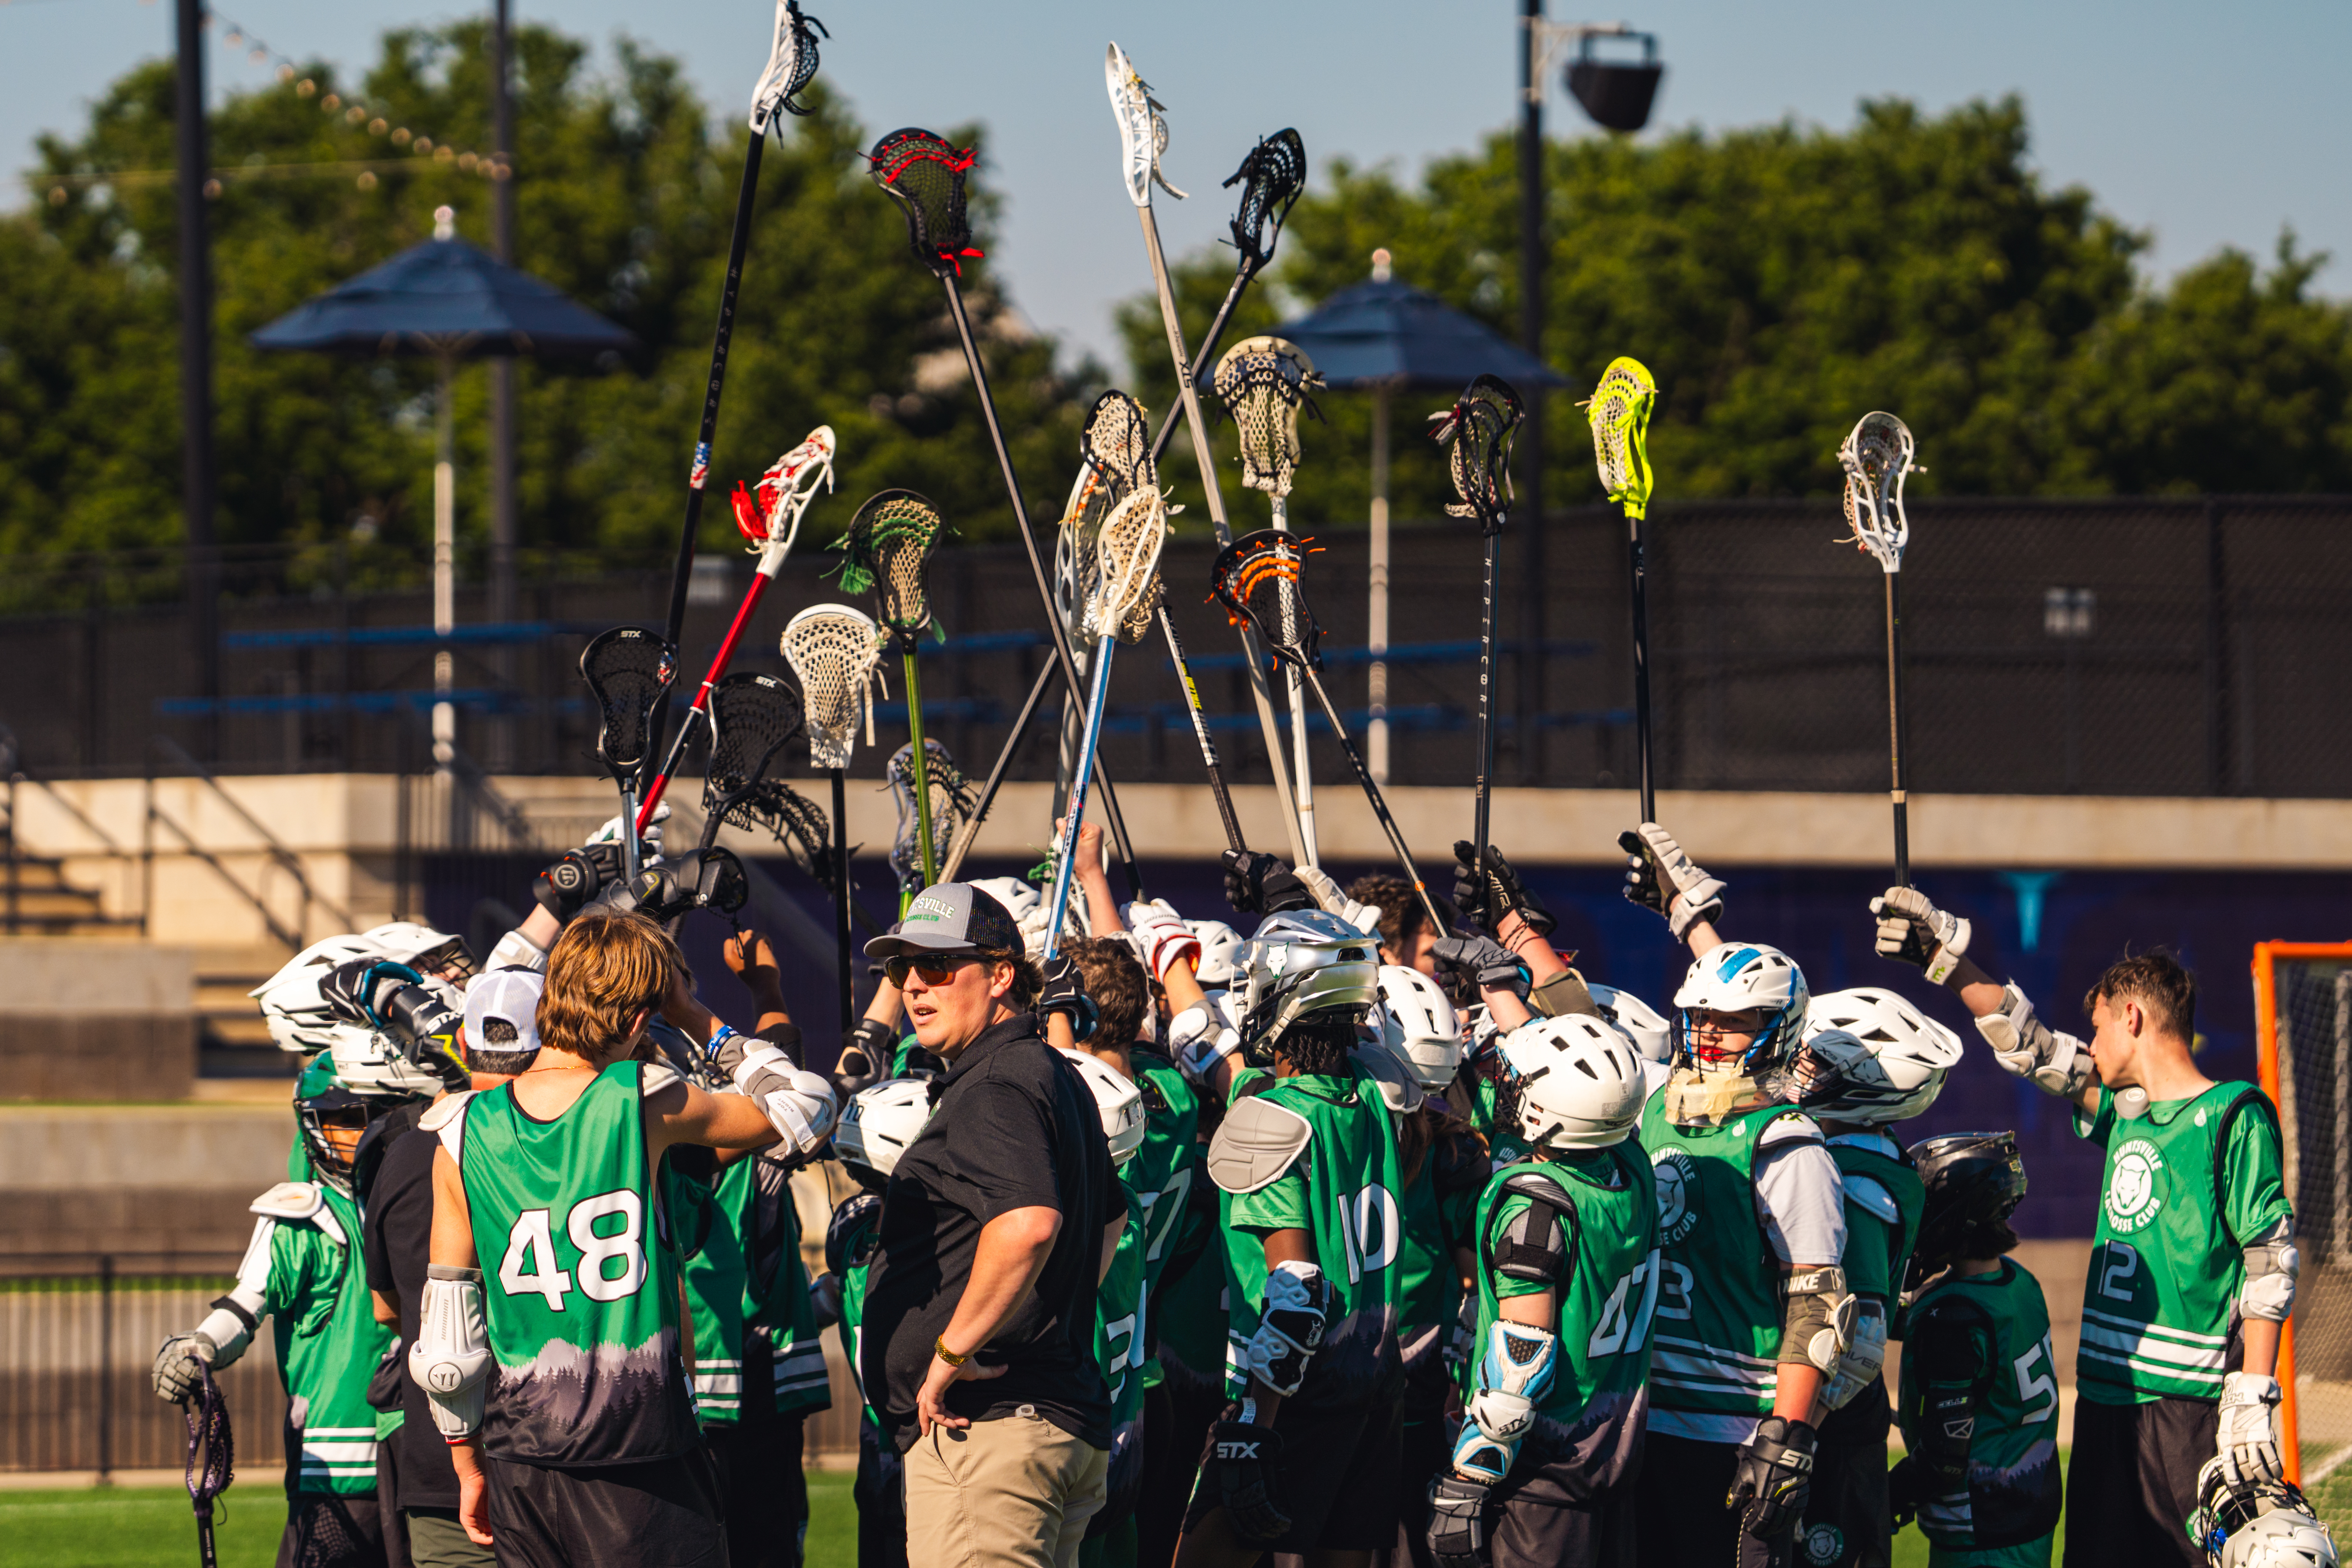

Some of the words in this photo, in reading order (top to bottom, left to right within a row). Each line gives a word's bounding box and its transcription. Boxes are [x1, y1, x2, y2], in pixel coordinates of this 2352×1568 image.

[1181, 362, 1194, 389] STX
[620, 630, 642, 639] STX
[1479, 558, 1492, 721] HYPERCORE
[755, 675, 777, 689] STX
[426, 1011, 463, 1034] STX
[777, 1098, 794, 1112] RIGHT
[777, 1102, 787, 1112] TOP
[1651, 1147, 1696, 1182] UNTSVILLE
[2113, 1140, 2163, 1171] HUNTSVILLE
[2105, 1190, 2133, 1233] LACROSSE
[2135, 1197, 2161, 1228] CLUB
[1337, 1182, 1400, 1286] 10
[1672, 1211, 1697, 1242] CLUB
[498, 1188, 649, 1313] 48
[1783, 1272, 1821, 1292] NIKE
[2097, 1238, 2138, 1302] 12
[440, 1298, 450, 1341] WARRIOR
[1498, 1418, 1527, 1436] STX
[1217, 1442, 1261, 1459] STX
